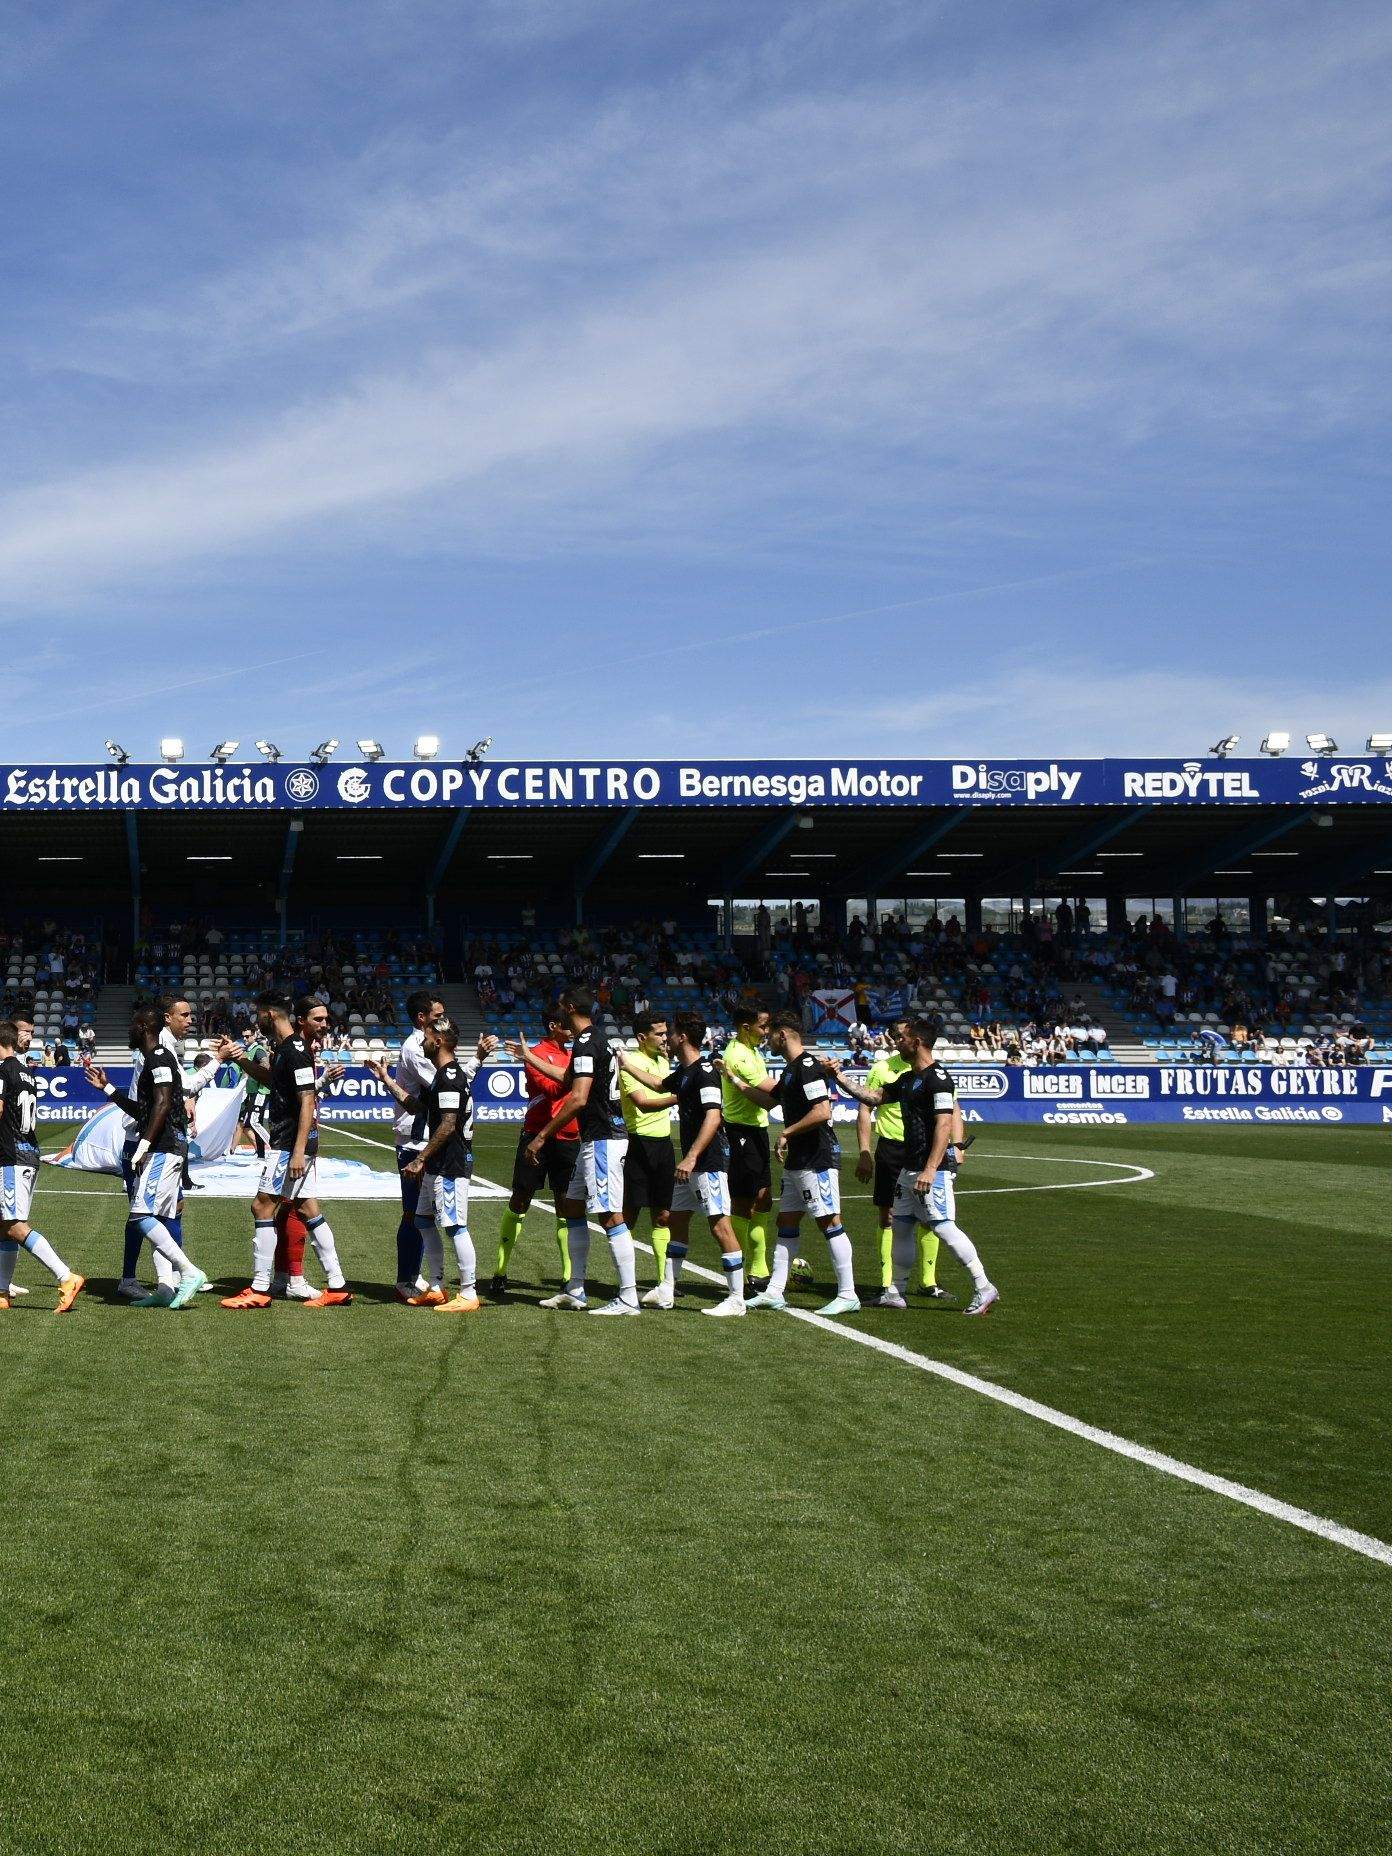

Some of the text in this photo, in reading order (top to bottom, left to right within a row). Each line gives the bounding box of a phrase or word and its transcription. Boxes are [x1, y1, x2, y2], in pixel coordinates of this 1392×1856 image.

[4, 767, 277, 804] Estrella Galicia
[383, 768, 660, 801] COPYCENTRO
[680, 768, 923, 803] Bernesga Motor
[952, 764, 1082, 800] Disaply
[1124, 771, 1260, 797] REDYTEL
[1160, 1069, 1262, 1095] FRUTAS
[1271, 1069, 1358, 1095] GEYRE
[1043, 1113, 1127, 1123] cosmos
[1183, 1106, 1321, 1121] Estrella Galicia
